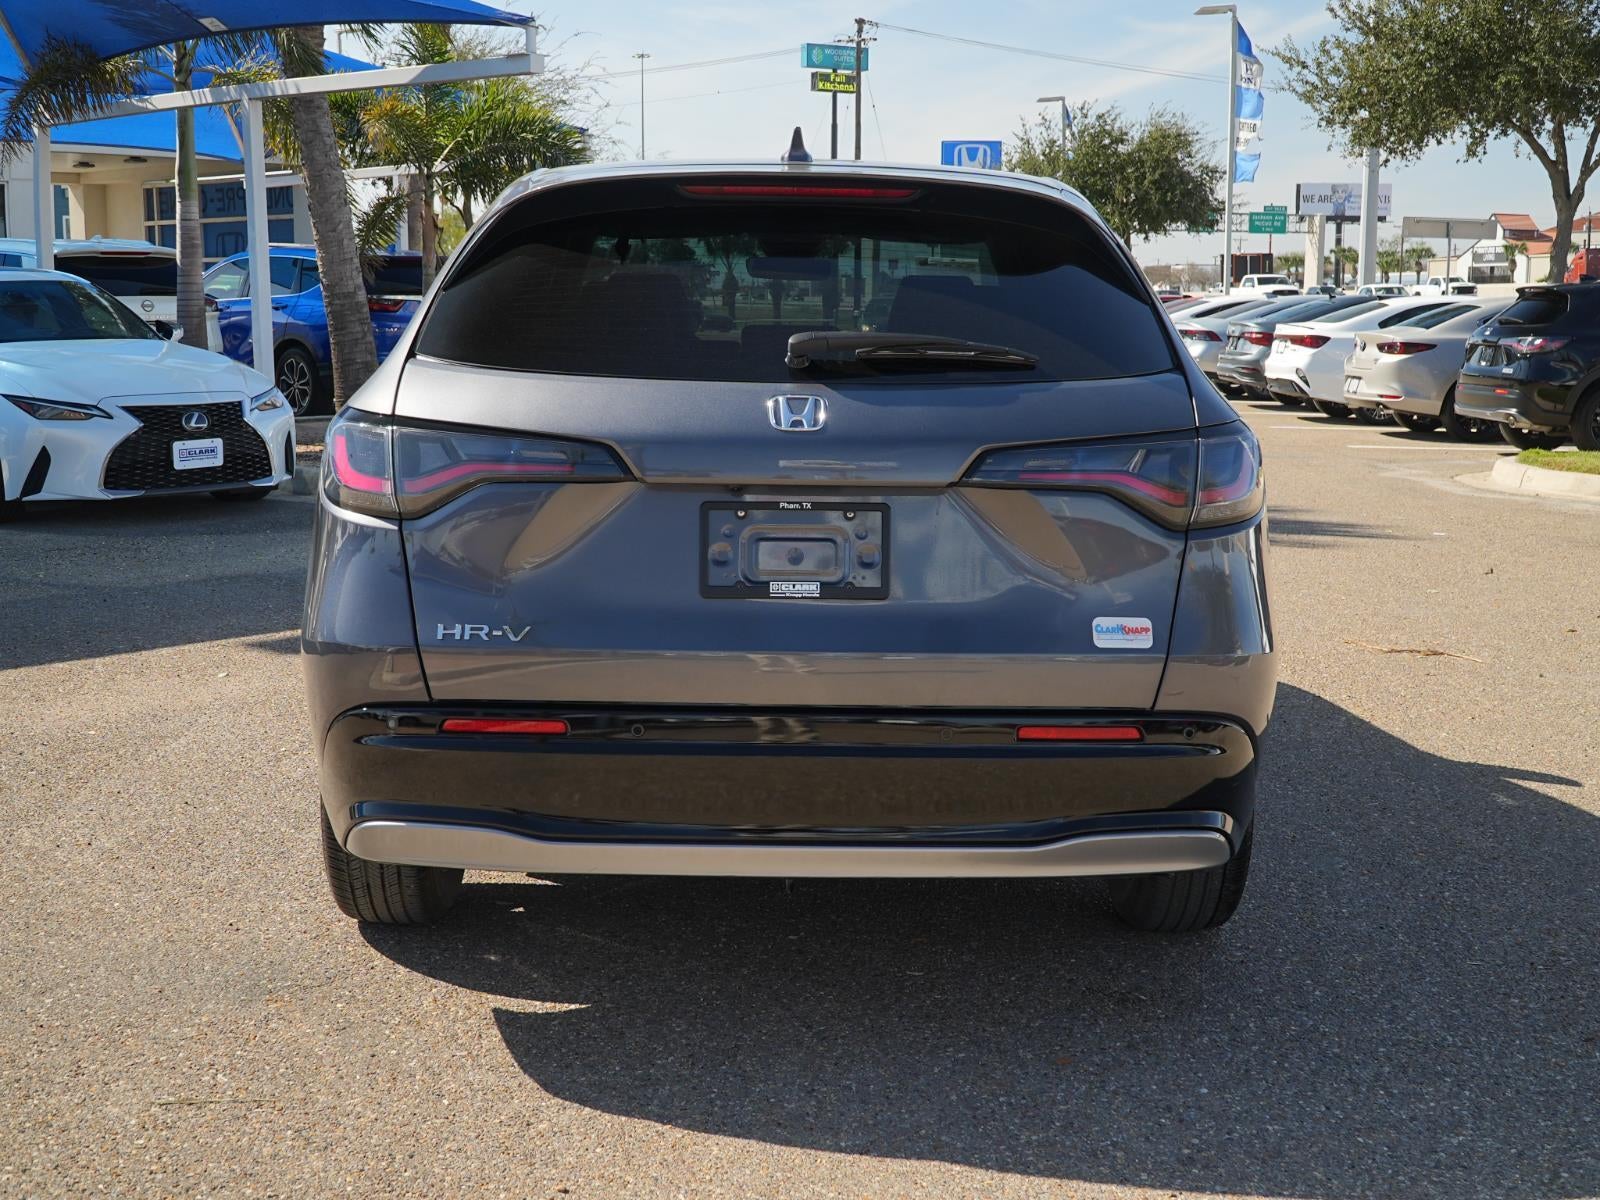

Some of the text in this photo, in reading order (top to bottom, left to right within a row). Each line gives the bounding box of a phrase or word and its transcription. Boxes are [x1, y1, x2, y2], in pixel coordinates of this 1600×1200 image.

[830, 74, 846, 82] Full
[1302, 194, 1316, 204] WE
[1317, 194, 1333, 204] ARE
[436, 623, 532, 642] HR-V
